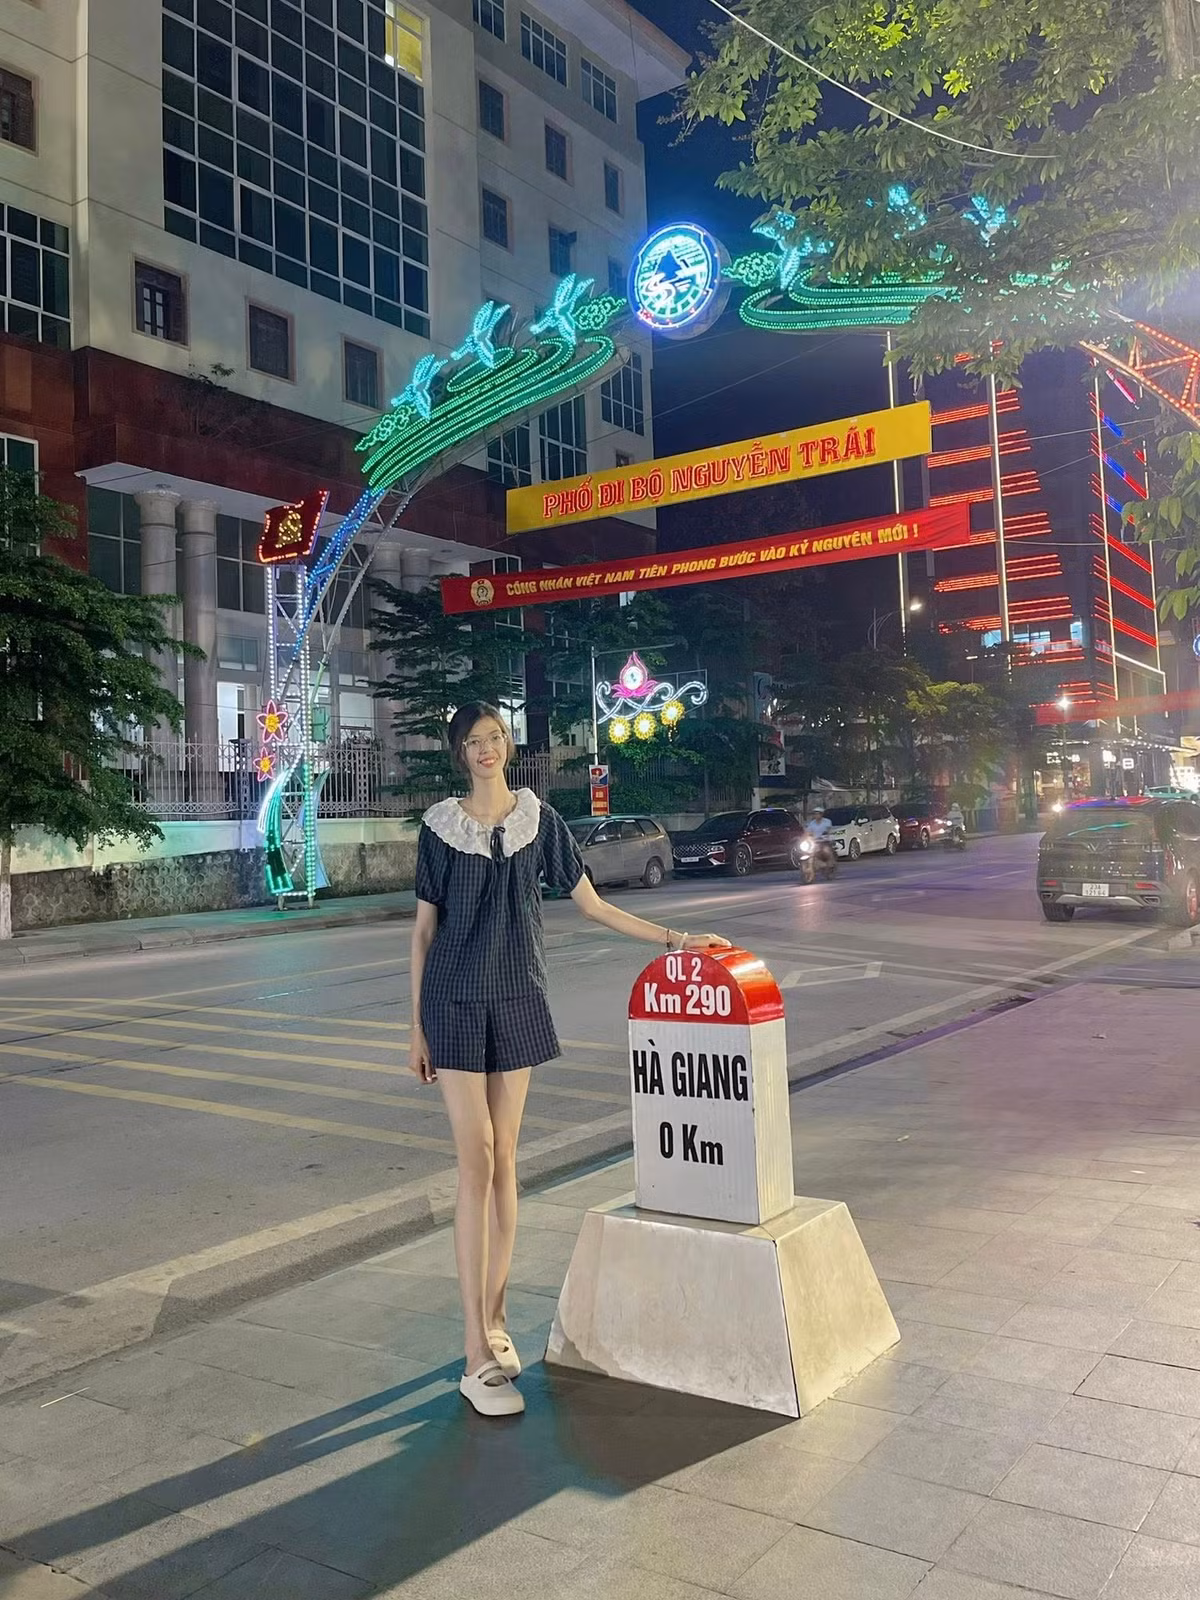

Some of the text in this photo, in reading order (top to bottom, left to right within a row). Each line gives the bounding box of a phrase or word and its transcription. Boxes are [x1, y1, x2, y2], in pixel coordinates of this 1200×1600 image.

[543, 425, 876, 518] PHỐ ĐI BỘ NGUYỄN TRÃI
[506, 523, 919, 596] CÔNG NHÂN VIỆT NAM TIÊN PHONG BƯỚC VÀO KỶ NGUYÊN MỚI !
[665, 955, 702, 983] QL 2
[644, 982, 731, 1017] Km 290
[632, 1038, 749, 1102] HÀ GIANG
[659, 1121, 724, 1166] 0 Km
